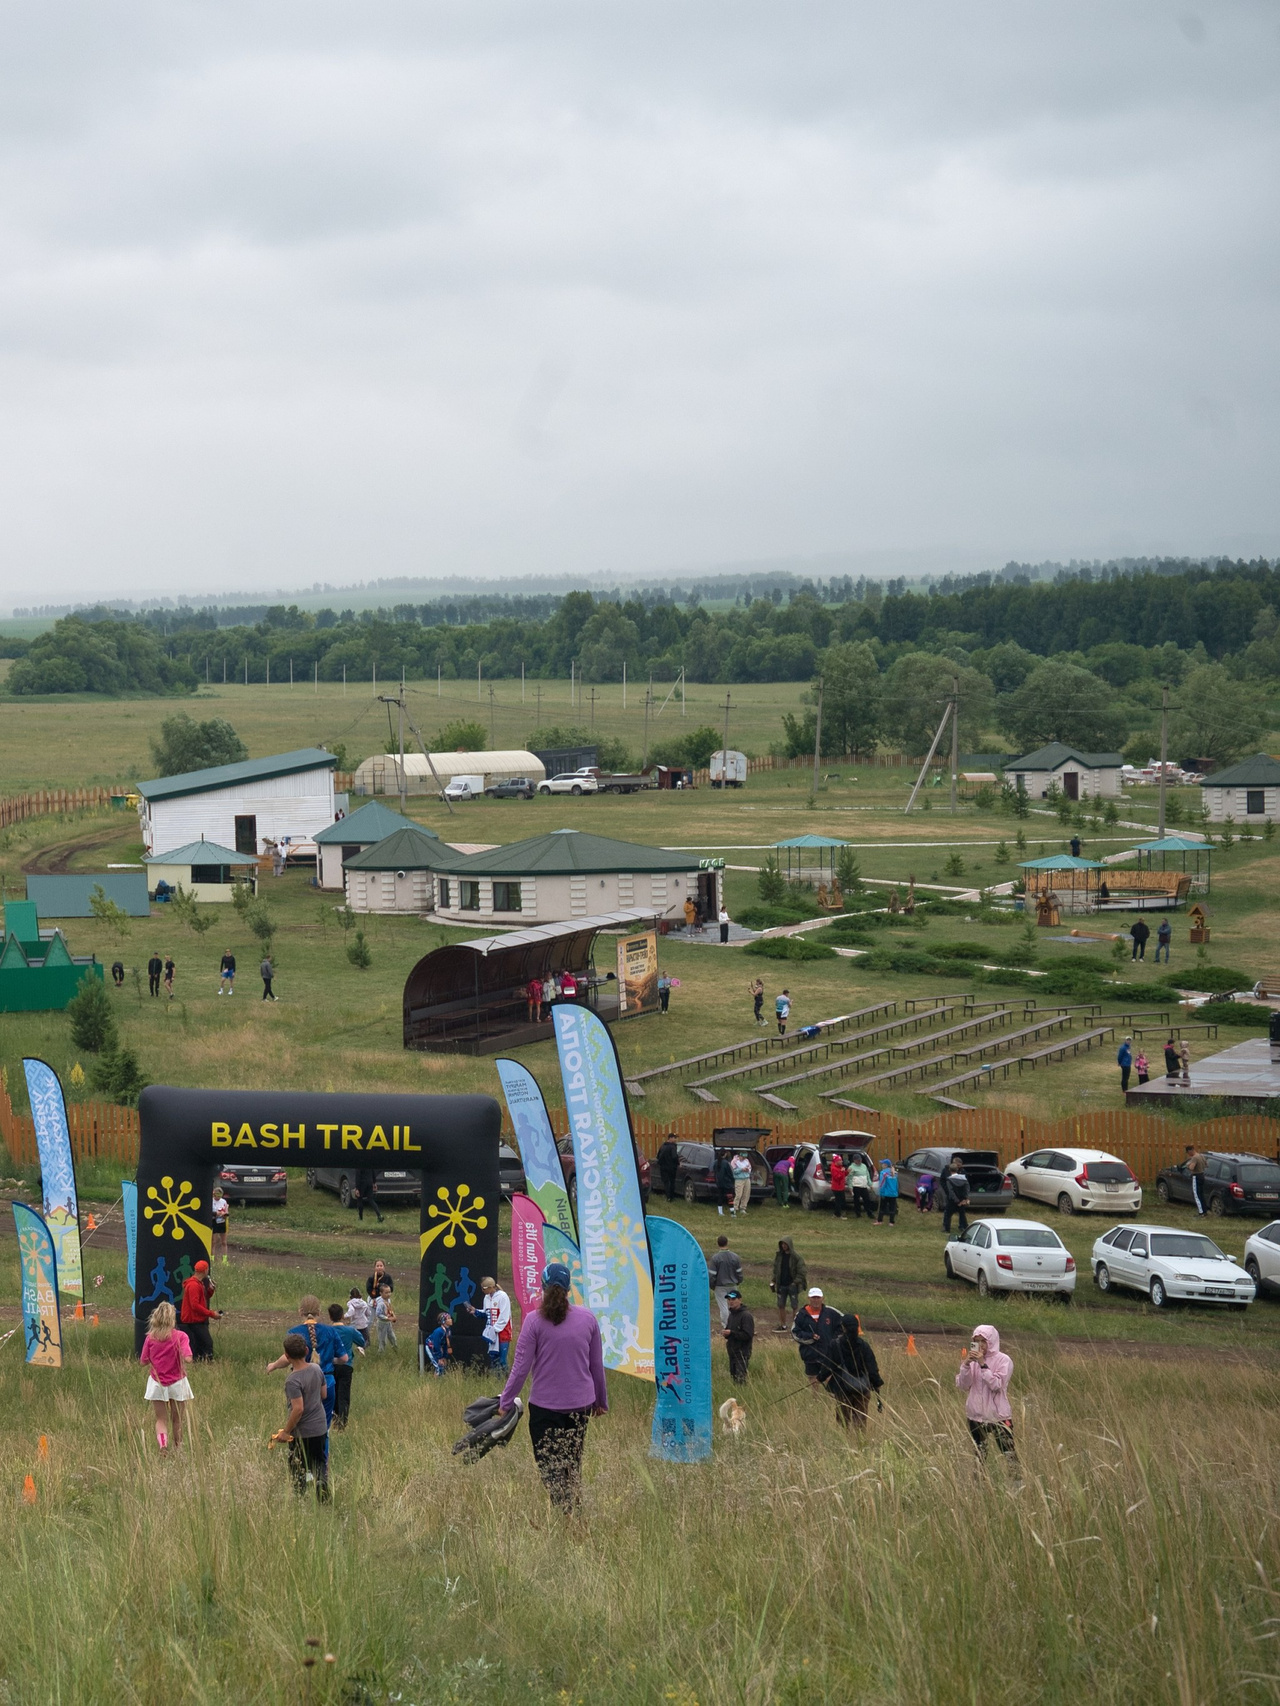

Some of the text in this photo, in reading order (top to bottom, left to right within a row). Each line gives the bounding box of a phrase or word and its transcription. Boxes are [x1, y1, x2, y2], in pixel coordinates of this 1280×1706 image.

[211, 1121, 422, 1152] BASH TRAIL
[658, 1264, 682, 1376] Lady Run Ufa
[681, 1263, 692, 1404] СПОРТИВНОЕ СООБЩЕСТВО
